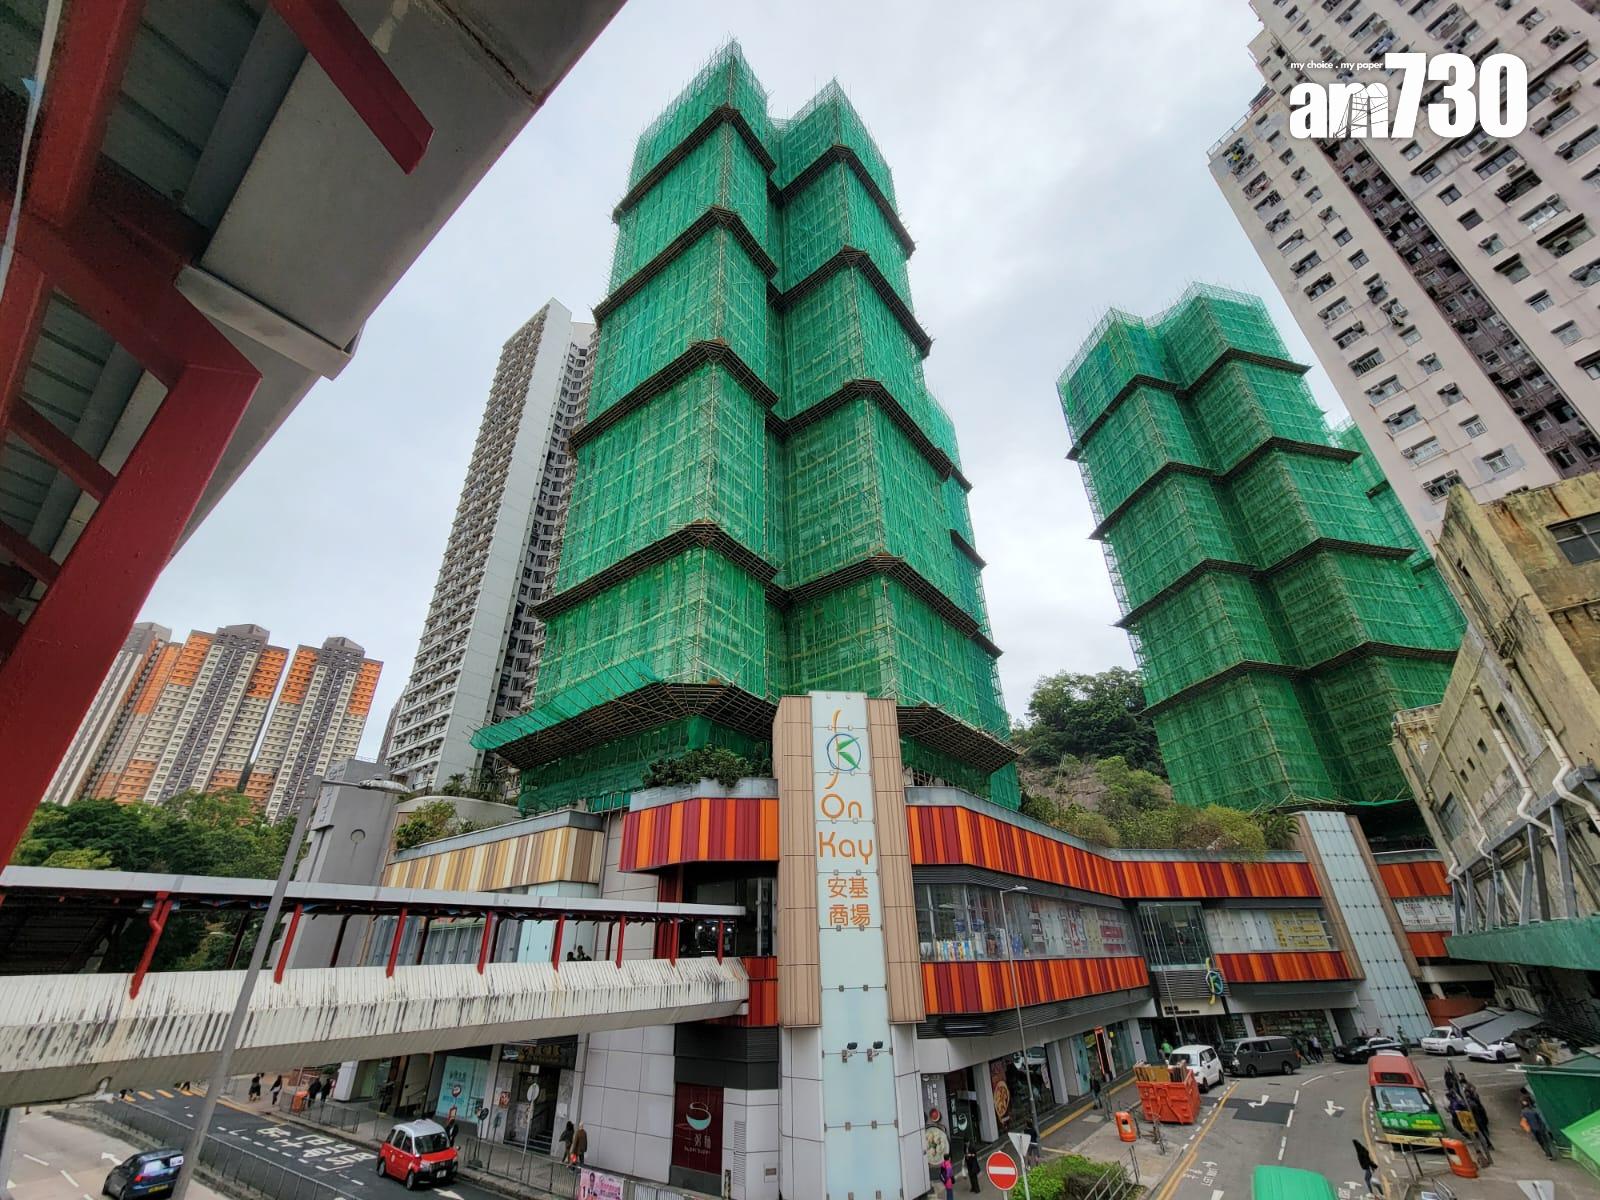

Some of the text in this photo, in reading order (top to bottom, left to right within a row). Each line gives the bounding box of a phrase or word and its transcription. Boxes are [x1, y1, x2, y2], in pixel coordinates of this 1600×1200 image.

[820, 793, 863, 819] On
[818, 832, 874, 865] Kay
[827, 876, 869, 898] 安基
[829, 903, 871, 927] 商場
[302, 1143, 357, 1158] STOP
[325, 1152, 378, 1165] BUS
